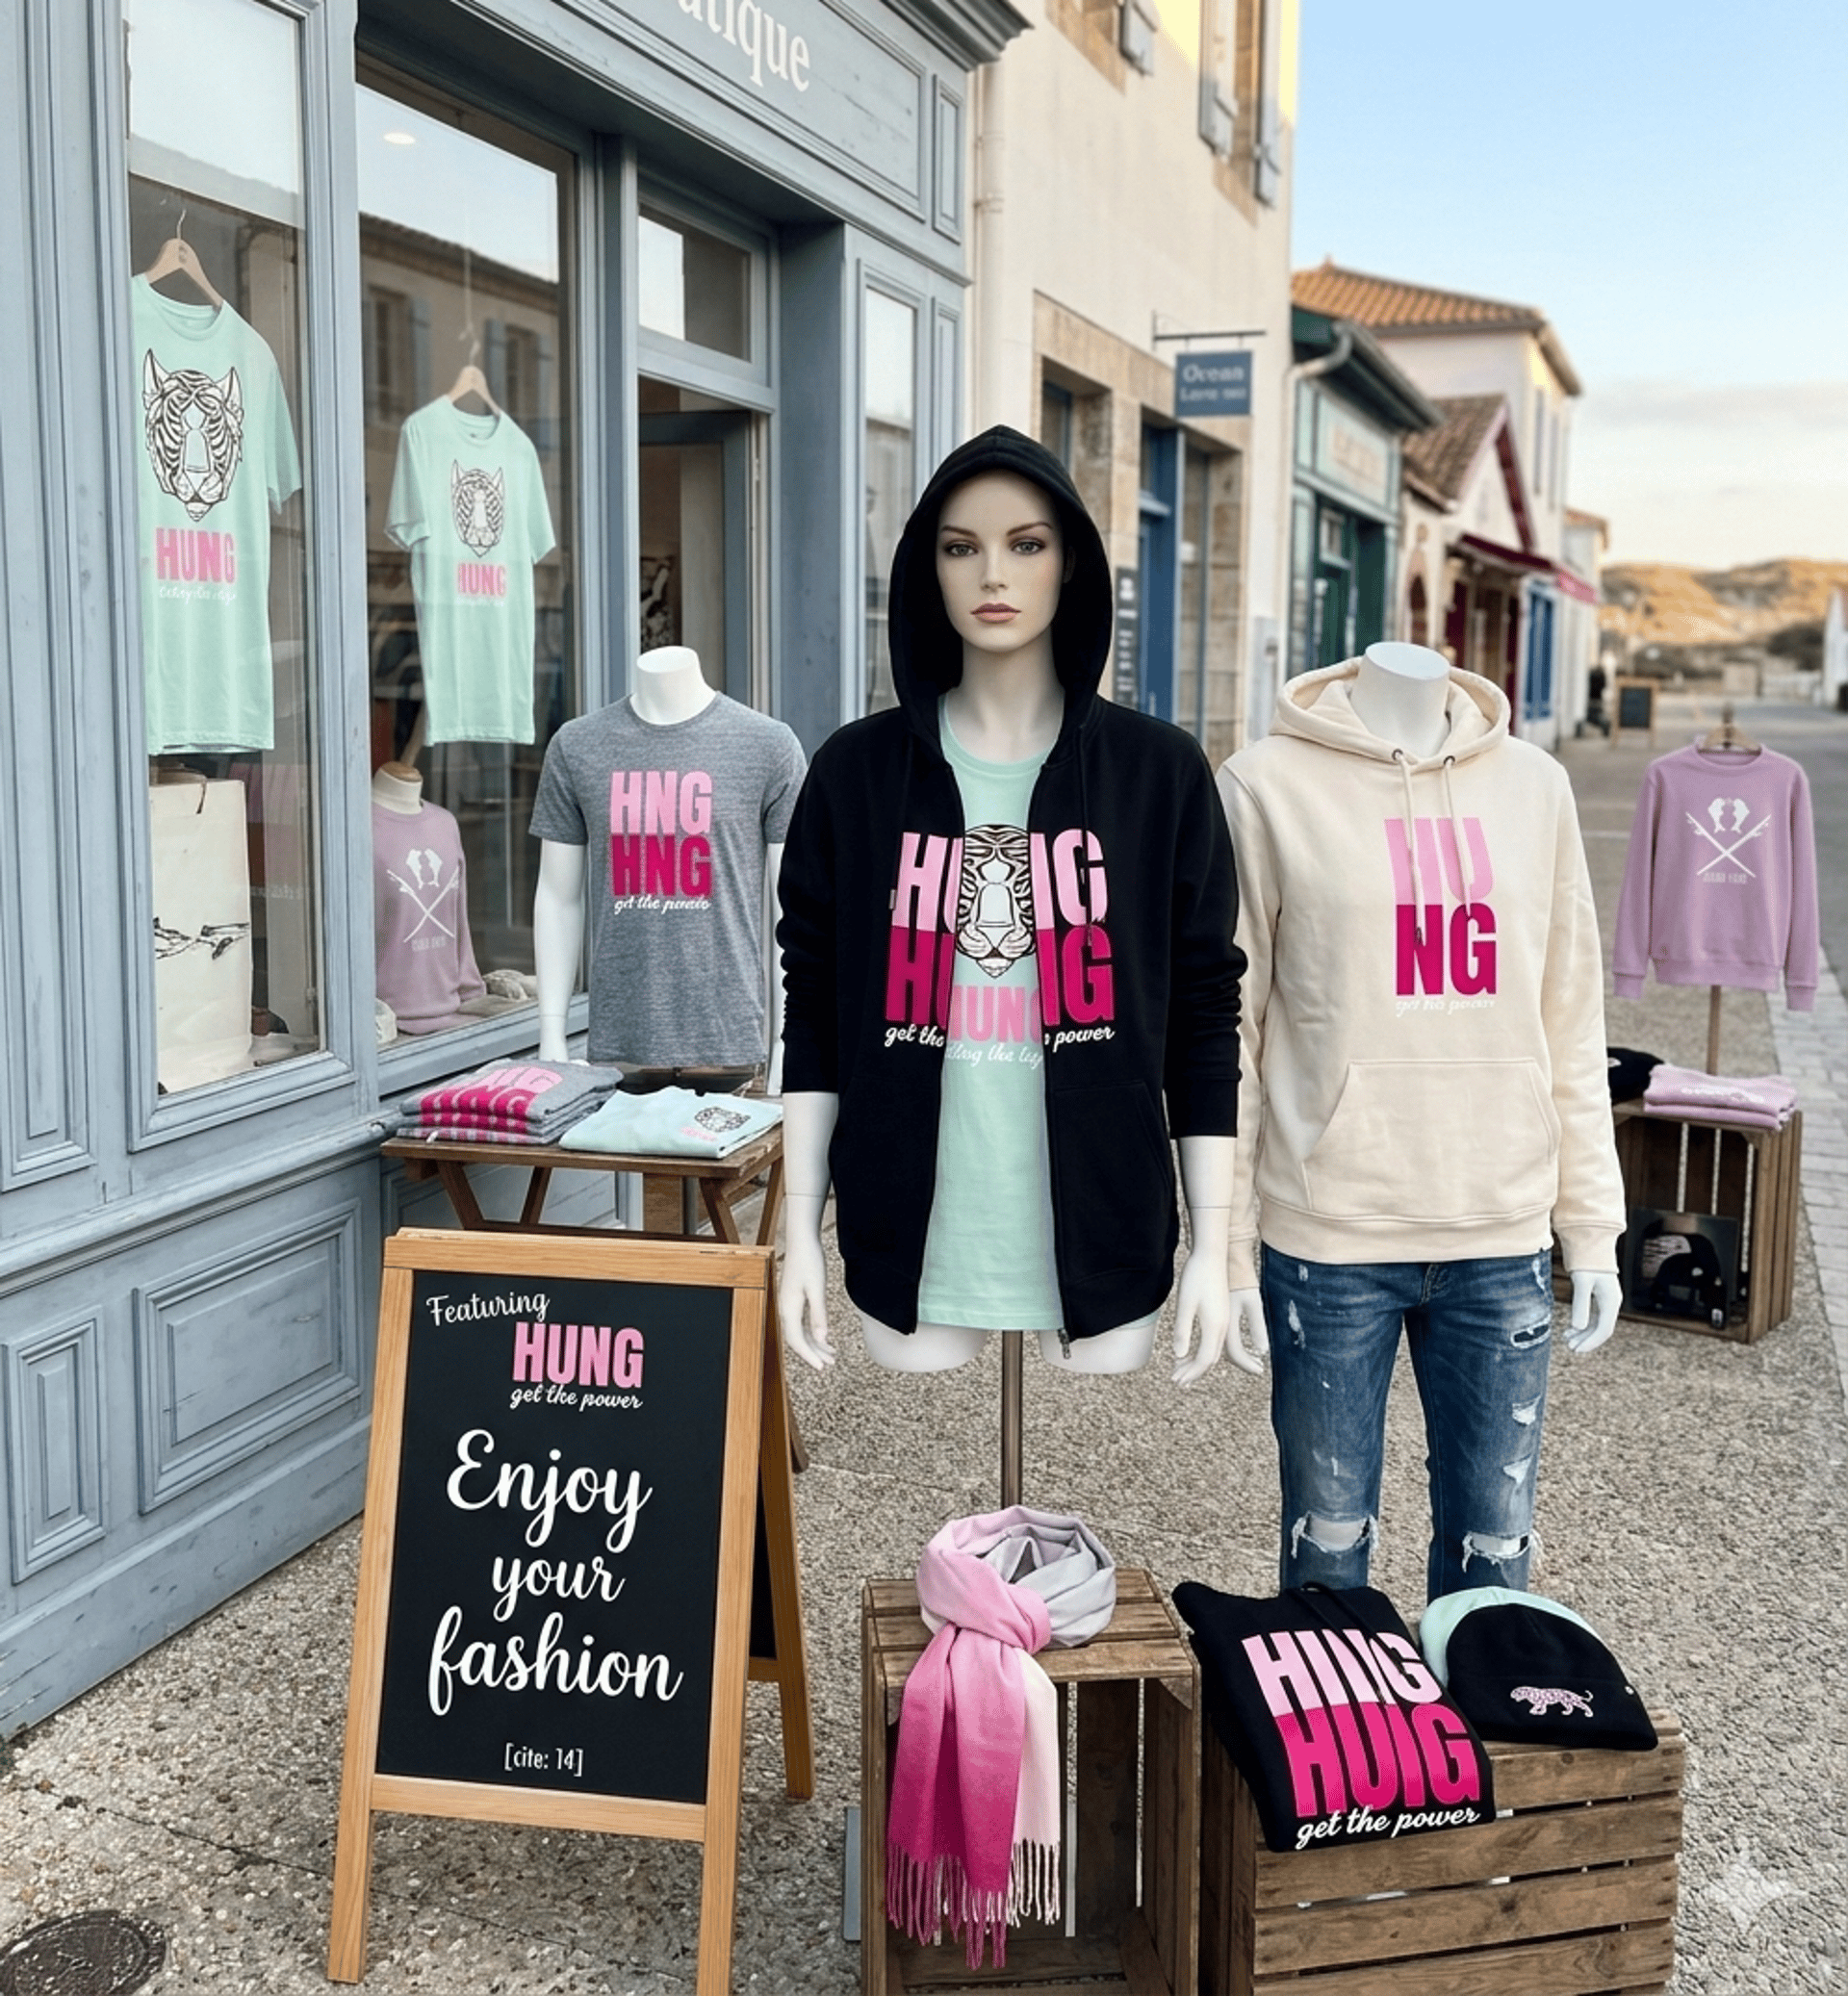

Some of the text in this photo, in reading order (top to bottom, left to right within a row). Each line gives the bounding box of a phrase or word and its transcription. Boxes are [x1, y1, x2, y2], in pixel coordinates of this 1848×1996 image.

[156, 527, 235, 584] HUNG
[610, 771, 713, 835] HNG
[611, 834, 712, 898] HNG
[1396, 903, 1497, 996] NG
[884, 1023, 917, 1048] get
[1053, 1025, 1116, 1053] power
[425, 1292, 550, 1326] Featuring
[512, 1320, 644, 1389] HUNG
[509, 1383, 643, 1413] get the power
[447, 1429, 654, 1553] Enjoy
[492, 1555, 626, 1623] your
[428, 1605, 684, 1716] fashion
[504, 1742, 583, 1778] [cite: 14]
[1295, 1804, 1481, 1850] get the power
